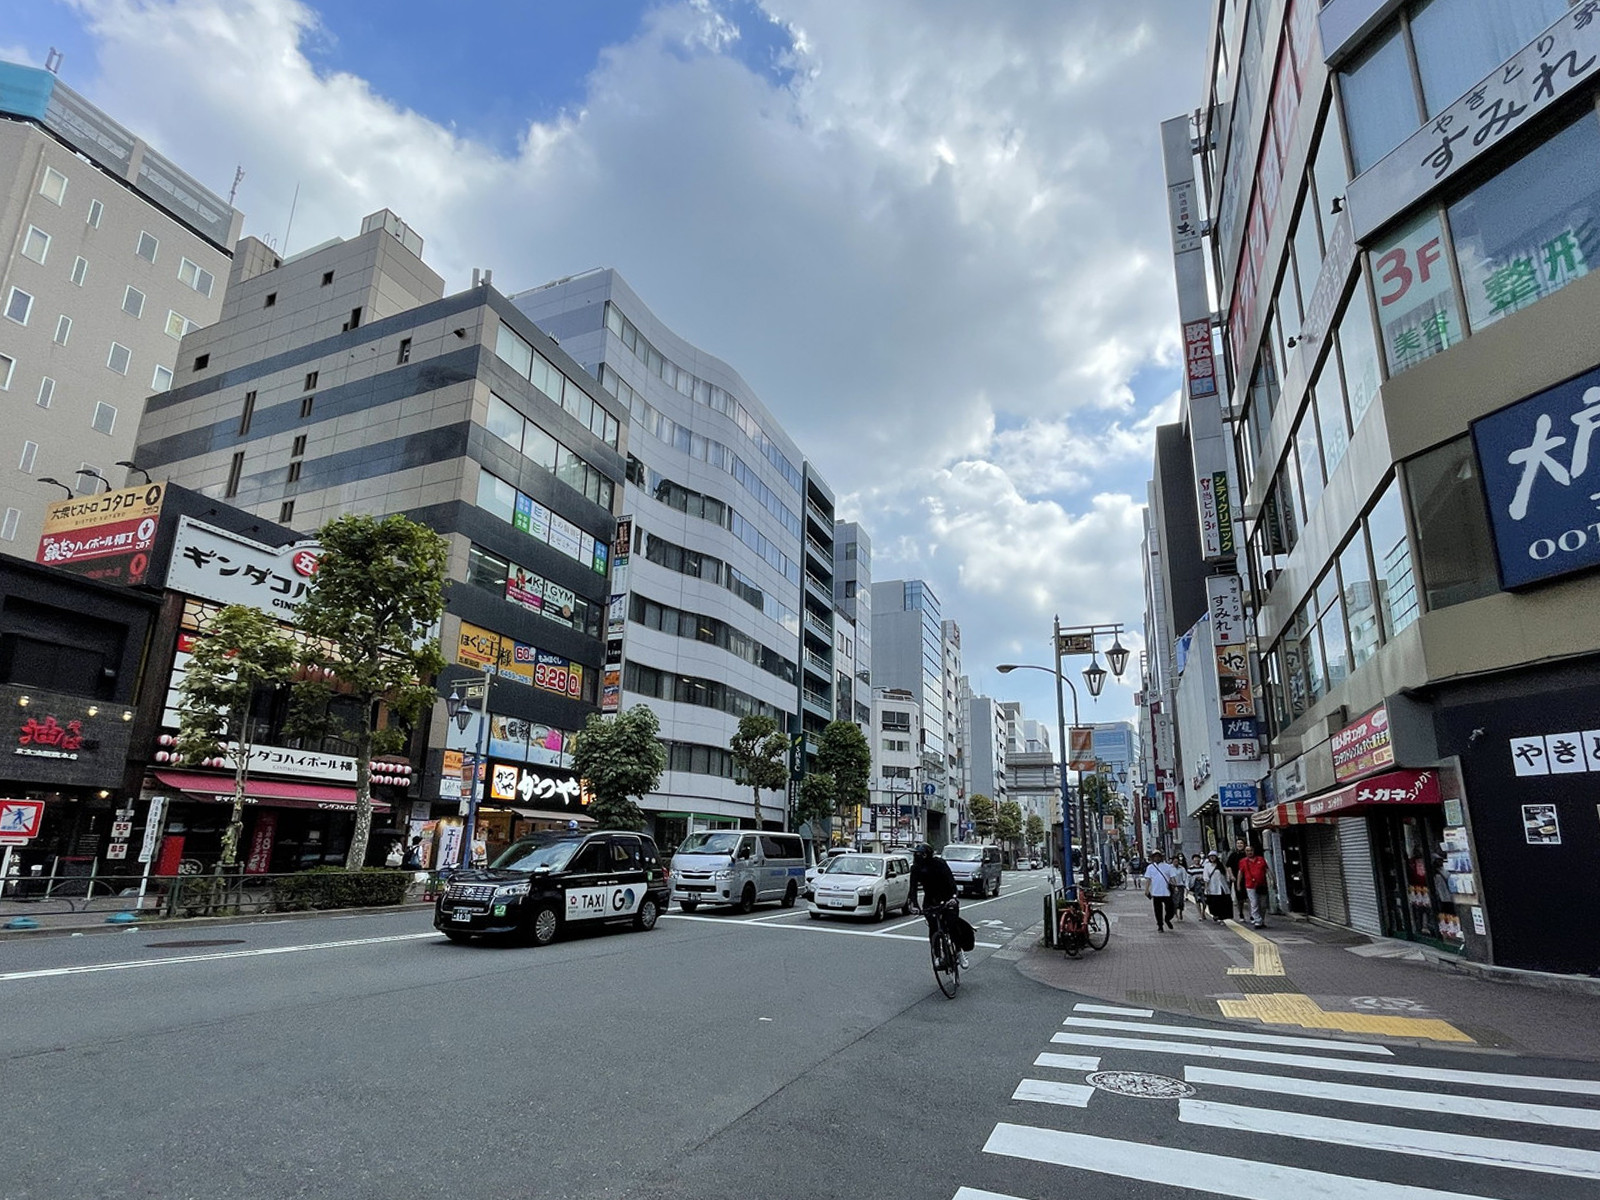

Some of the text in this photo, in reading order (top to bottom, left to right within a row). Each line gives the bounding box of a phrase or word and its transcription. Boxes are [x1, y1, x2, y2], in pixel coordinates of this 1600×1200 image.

[1432, 1, 1600, 135] やきとり家
[1421, 50, 1597, 179] すみれ
[1376, 236, 1441, 306] 3F
[1393, 309, 1450, 359] 美容
[101, 493, 143, 512] コタロー
[1203, 492, 1214, 518] 当ビル
[1214, 476, 1232, 551] シティクリニック
[1204, 521, 1216, 531] 3F
[551, 585, 573, 604] GYM
[1213, 595, 1232, 631] すみれ
[231, 748, 355, 772] ンダコハイボール横
[1227, 743, 1255, 757] 歯科
[517, 768, 580, 805] かつや
[1225, 789, 1251, 798] 英会話
[1357, 788, 1406, 801] メガネ
[1407, 771, 1432, 800] コンタクト
[215, 795, 258, 803] テイクウト
[1223, 798, 1255, 807] イーオン
[582, 894, 605, 908] TAXI
